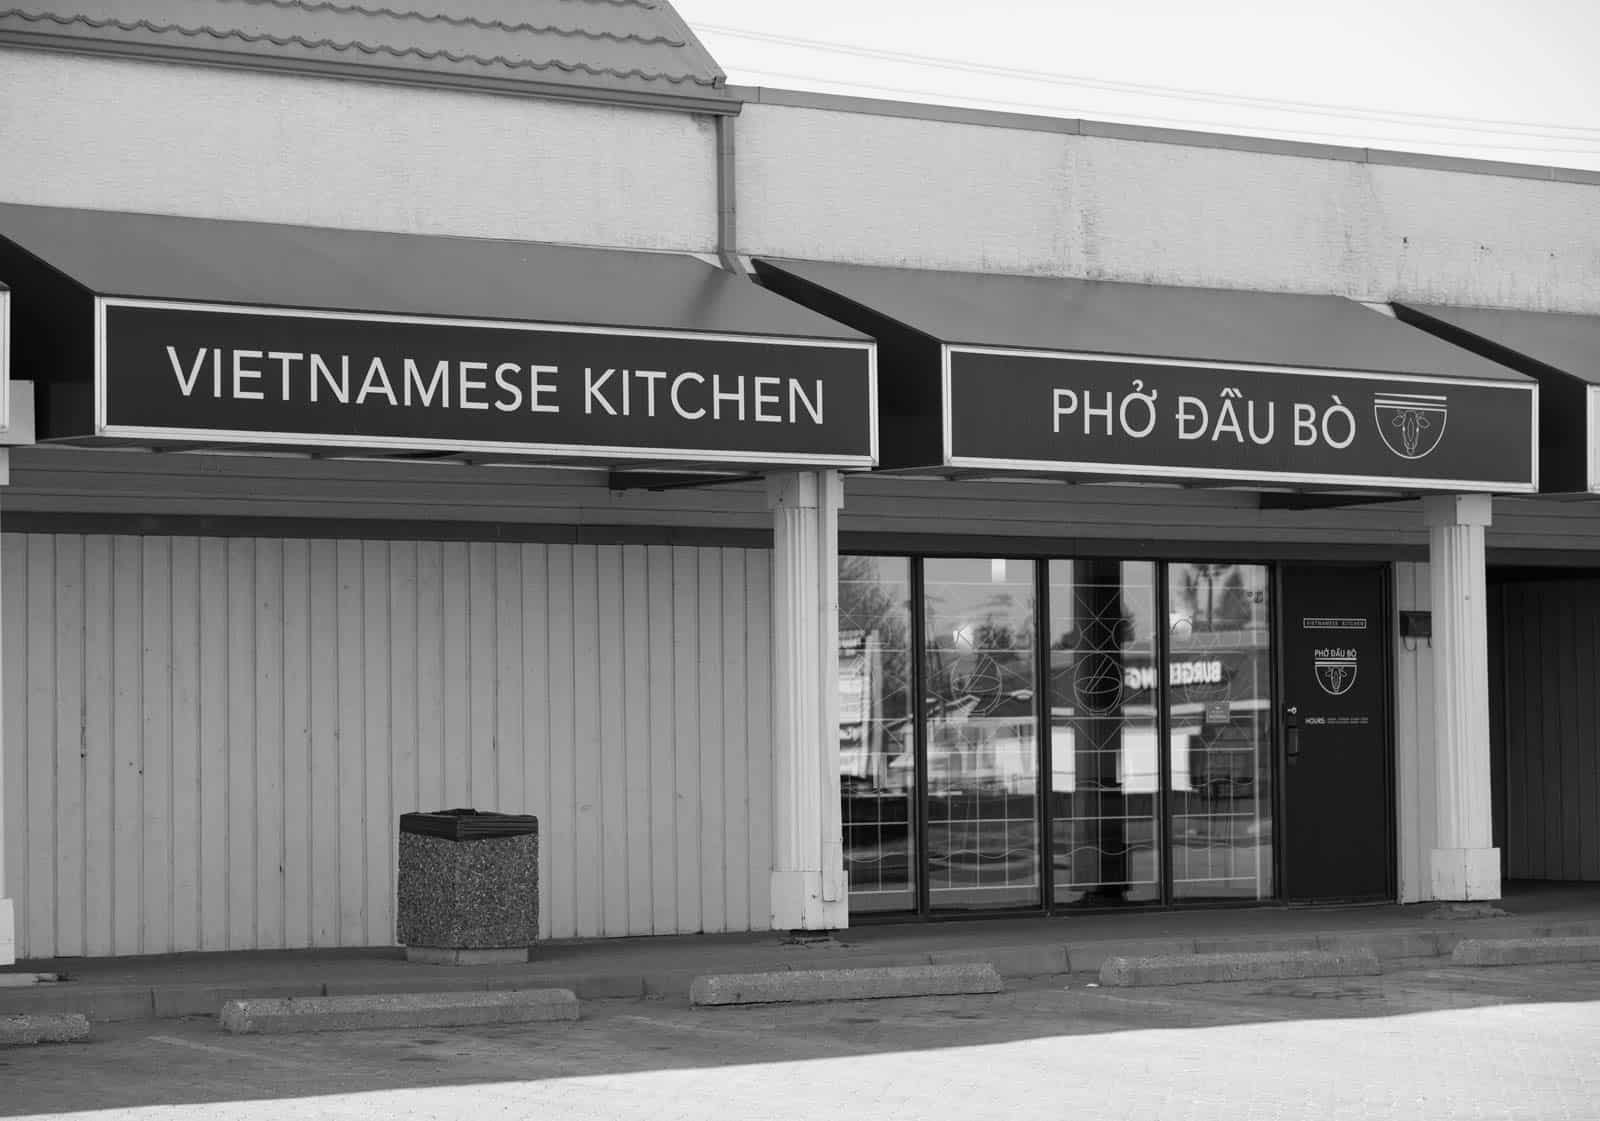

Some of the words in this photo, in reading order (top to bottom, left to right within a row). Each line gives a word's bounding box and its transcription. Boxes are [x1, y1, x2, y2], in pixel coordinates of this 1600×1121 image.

[166, 346, 560, 412] VIETNAMESE
[584, 367, 824, 425] KITCHEN
[1053, 378, 1158, 439] PHỞ
[1175, 387, 1275, 445] ĐẦU
[1294, 394, 1356, 449] BÒ
